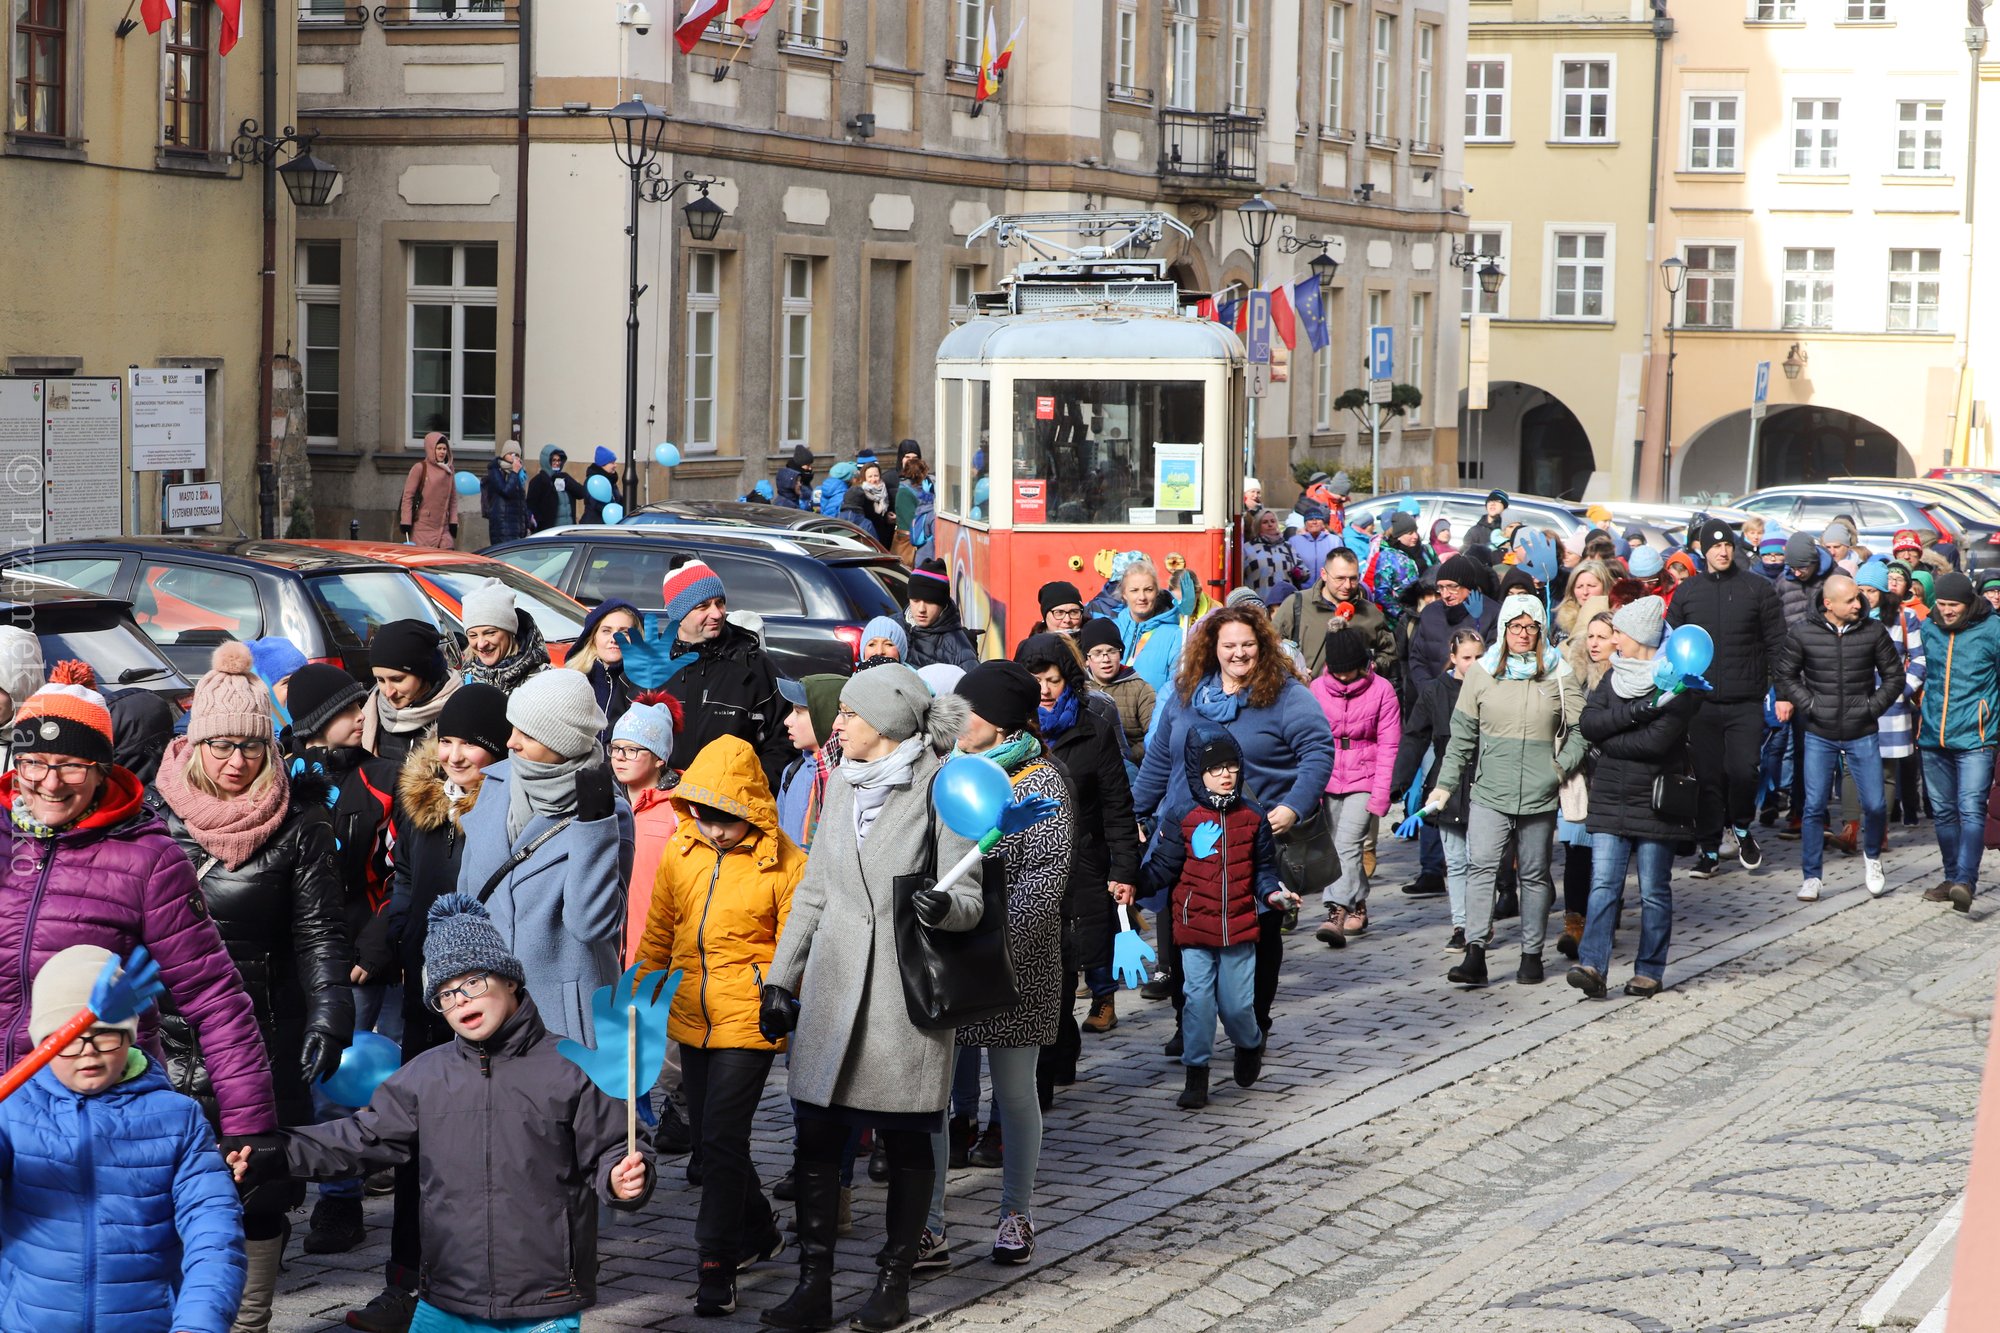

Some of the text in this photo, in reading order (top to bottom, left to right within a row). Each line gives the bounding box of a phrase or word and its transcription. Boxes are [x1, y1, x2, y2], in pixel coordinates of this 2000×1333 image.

[1253, 297, 1267, 341] P
[1375, 333, 1389, 373] P
[179, 491, 195, 501] MIASTO
[172, 505, 220, 518] SYSTEMEM OSTRZEGANIA
[42, 726, 57, 734] 4F
[703, 1261, 720, 1269] FILA
